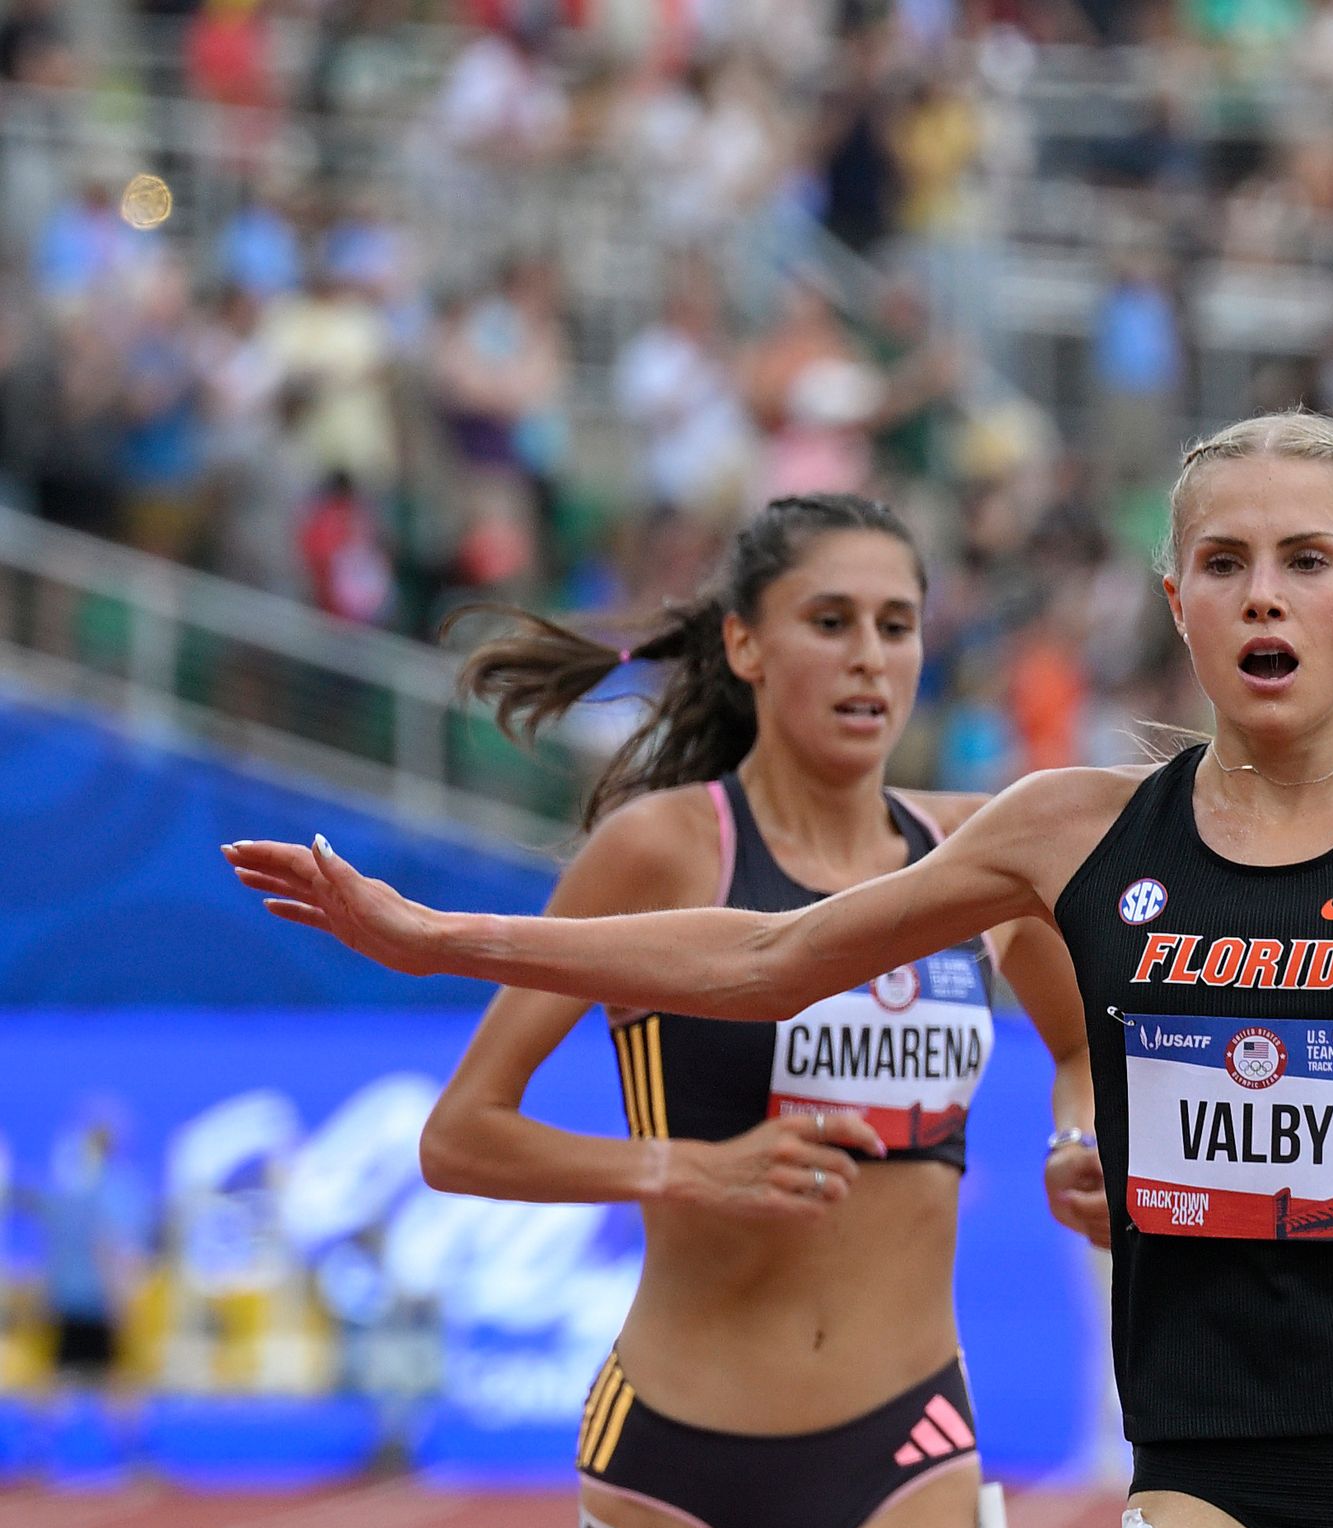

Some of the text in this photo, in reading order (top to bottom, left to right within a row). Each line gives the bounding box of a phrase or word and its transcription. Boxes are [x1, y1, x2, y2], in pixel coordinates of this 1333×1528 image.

[1123, 882, 1164, 921] SEC
[1161, 1033, 1212, 1049] USATF
[1307, 1029, 1329, 1044] U.S.
[786, 1024, 981, 1078] CAMARENA
[1307, 1061, 1333, 1072] TRACK
[1136, 1188, 1210, 1211] TRACKTOWN
[1171, 1204, 1204, 1226] 2024
